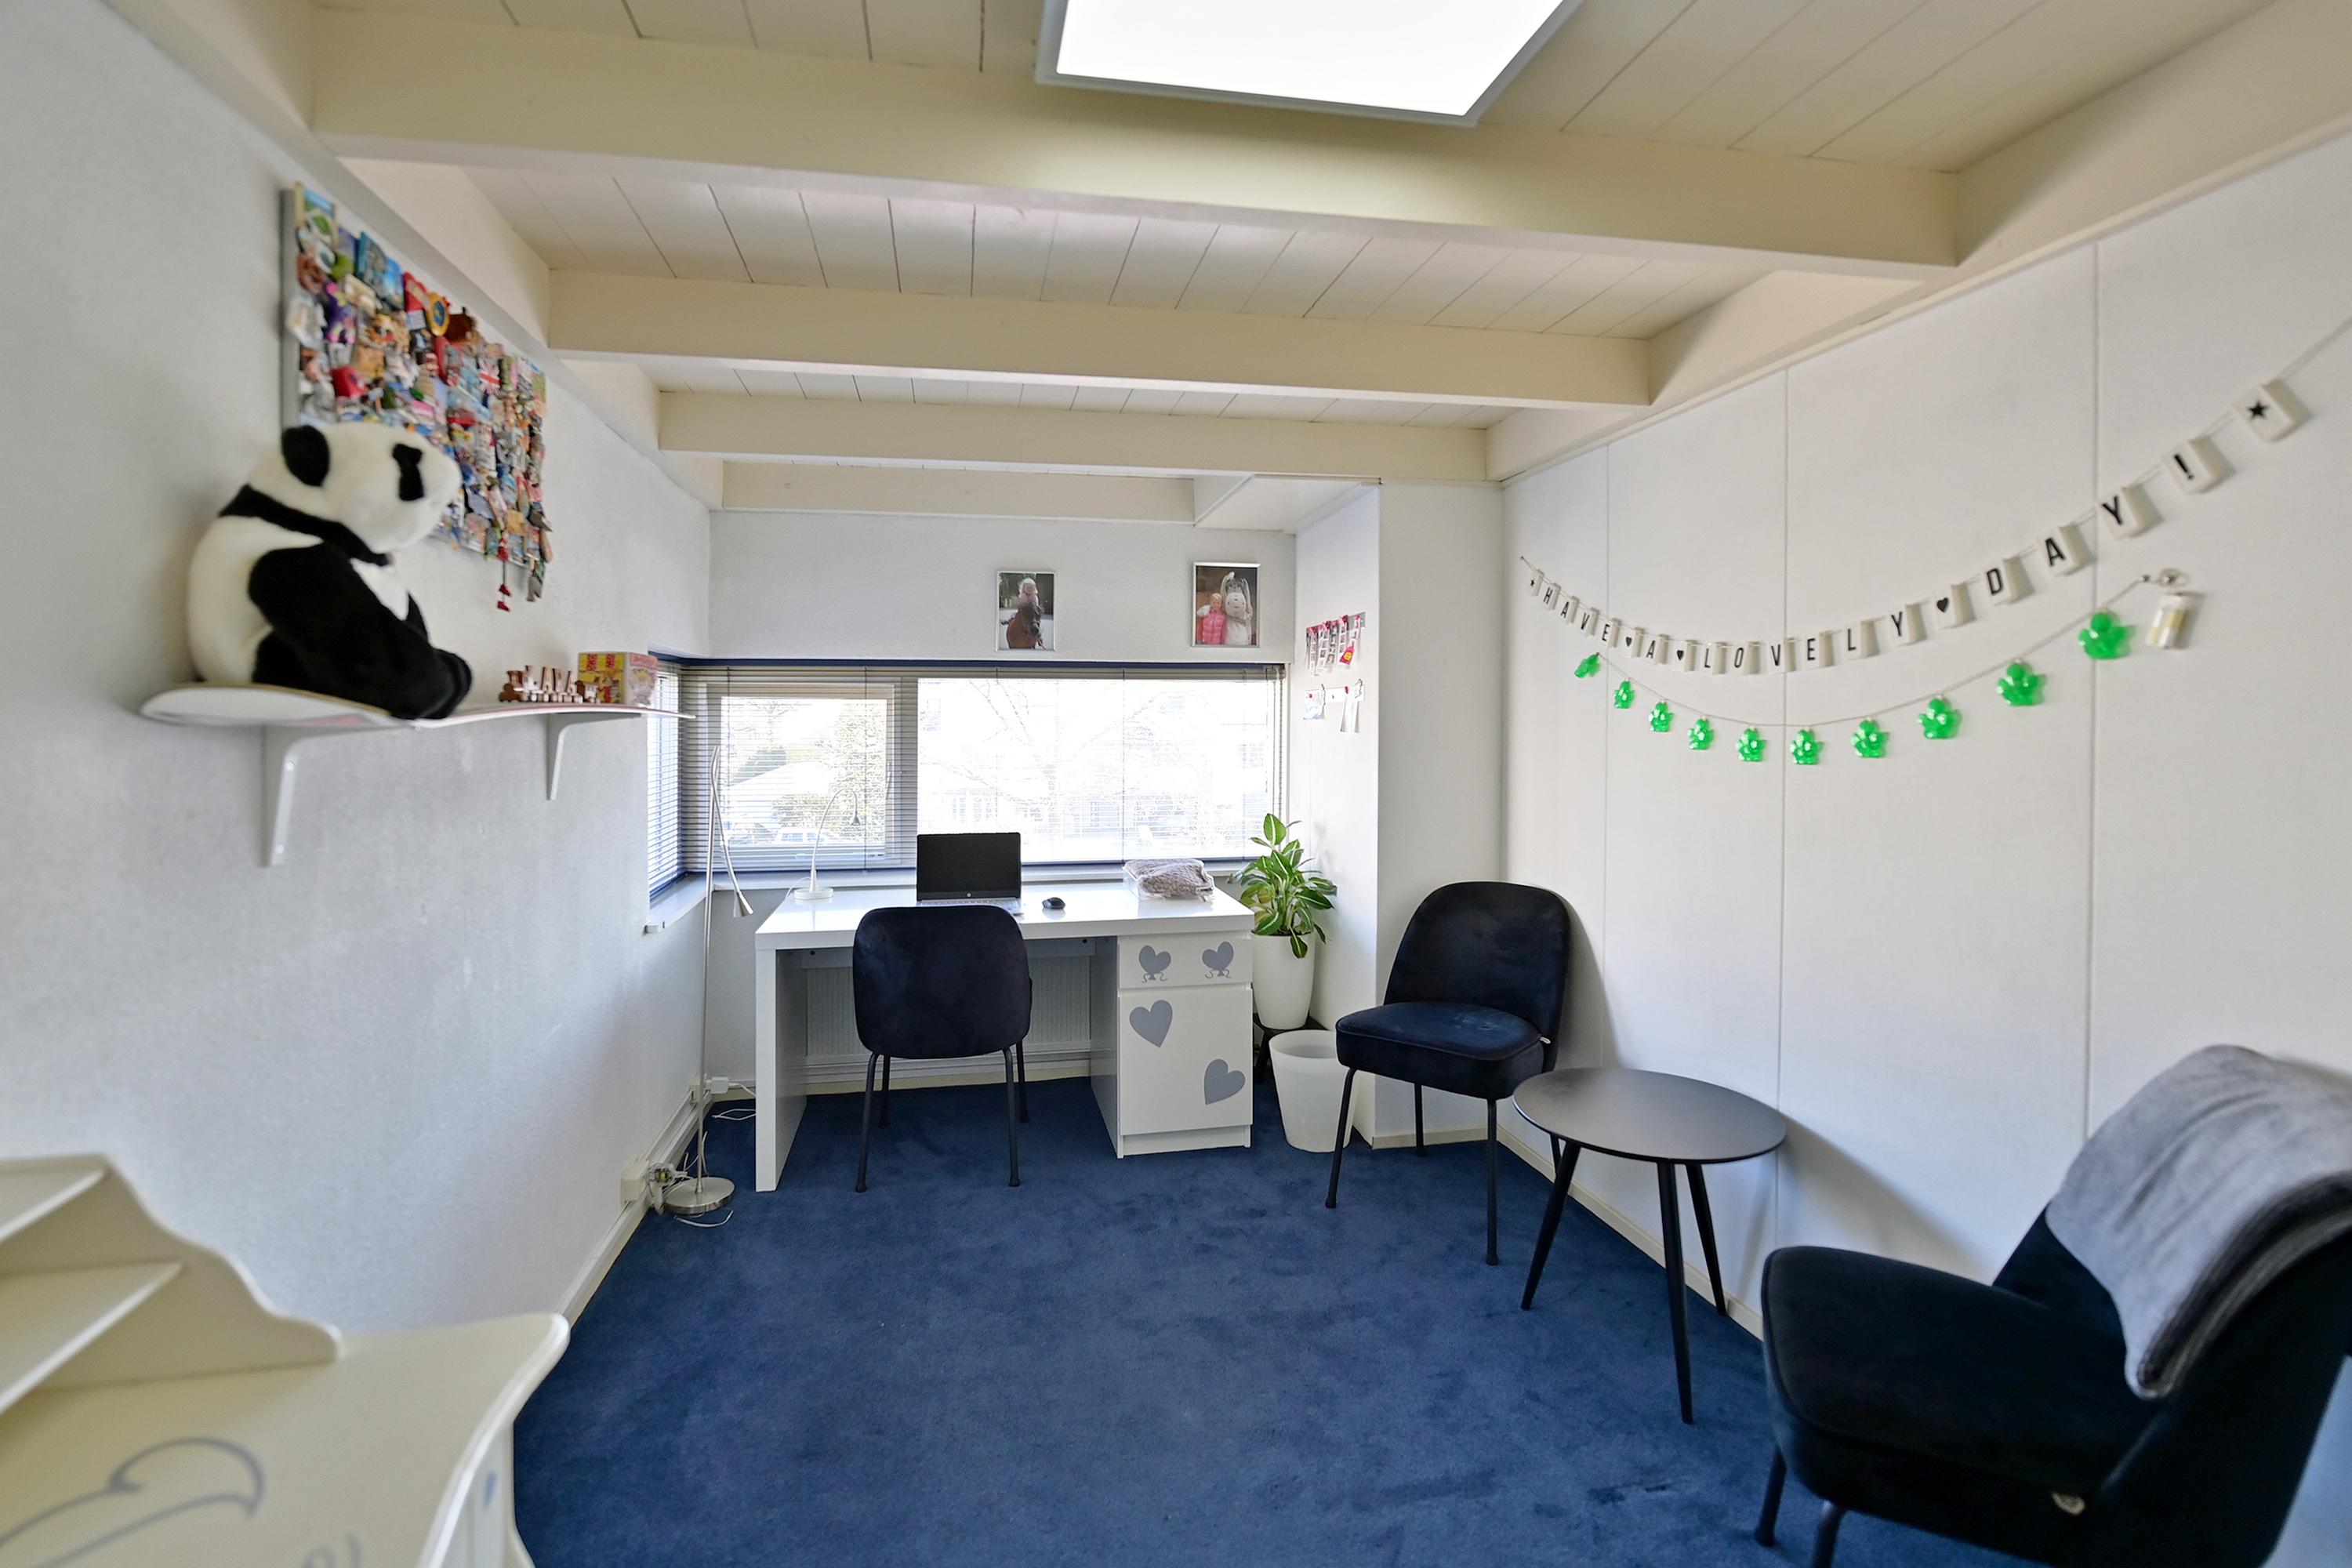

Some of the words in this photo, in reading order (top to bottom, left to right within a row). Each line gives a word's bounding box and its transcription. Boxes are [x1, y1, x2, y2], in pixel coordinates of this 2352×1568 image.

[1543, 586, 1610, 642] HAVE
[1646, 640, 1657, 659] A
[1704, 611, 1904, 669] LOVELY
